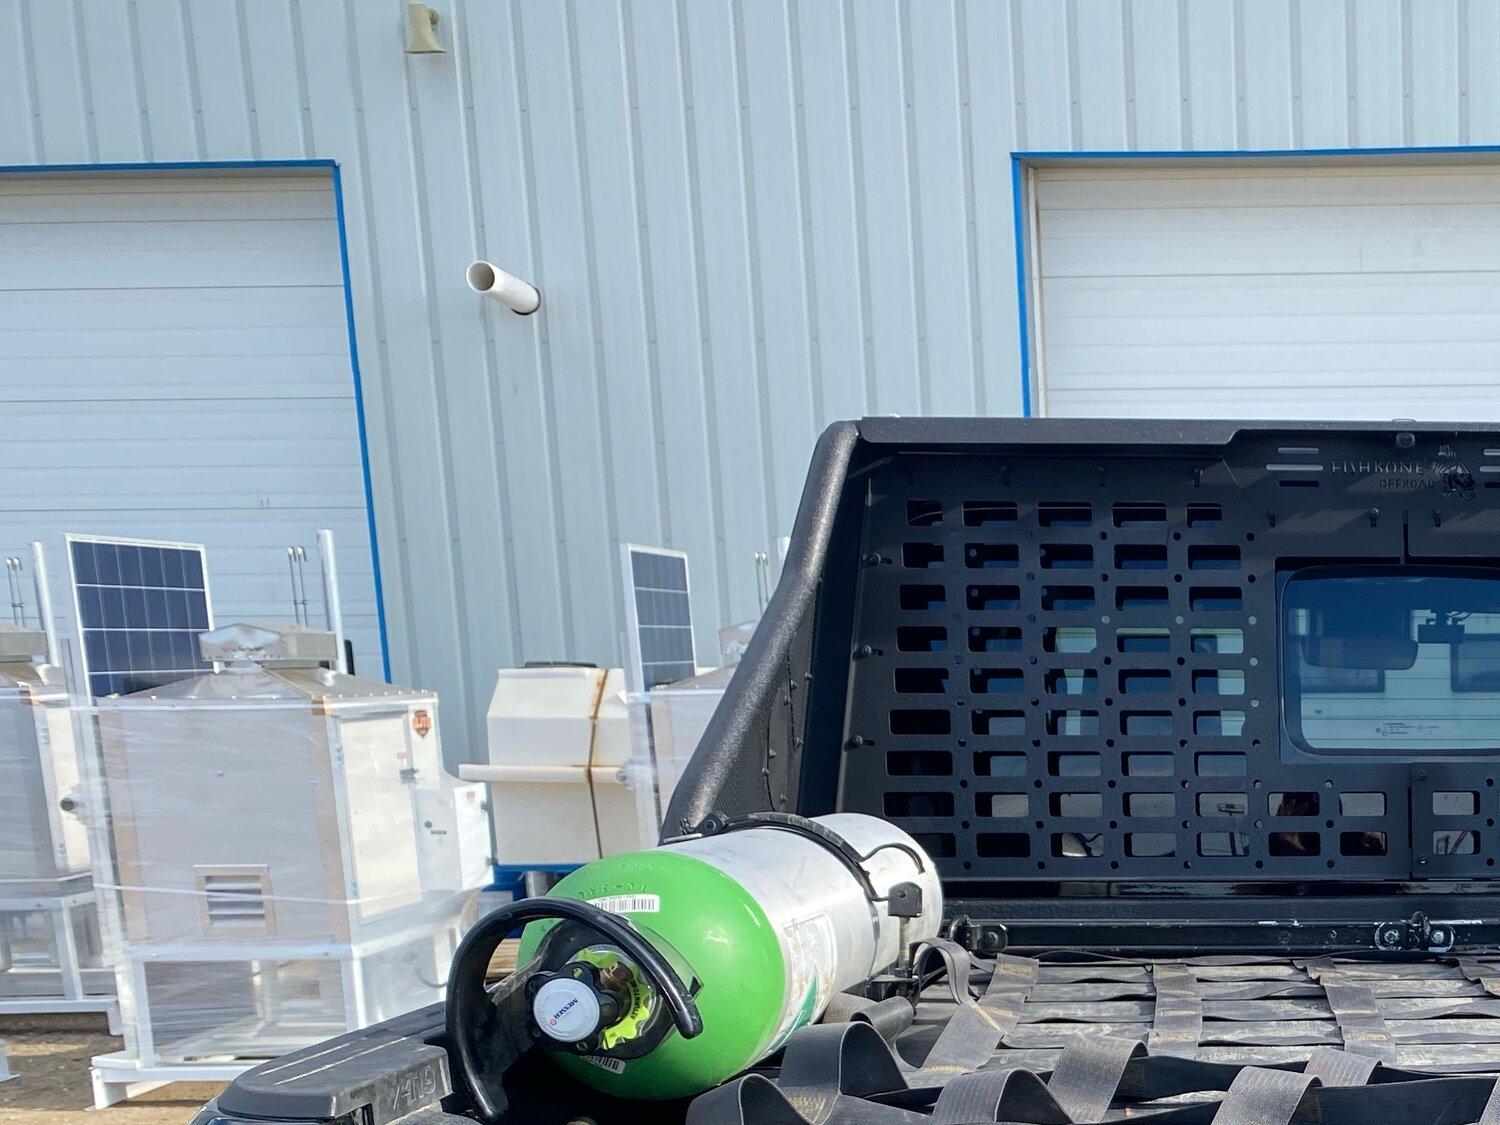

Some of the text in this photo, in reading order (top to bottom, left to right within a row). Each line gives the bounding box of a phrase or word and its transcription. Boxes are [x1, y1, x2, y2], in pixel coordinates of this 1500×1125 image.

[1331, 460, 1424, 475] FISHBONE
[1379, 478, 1435, 489] OFFROAD
[553, 998, 579, 1019] MESSER
